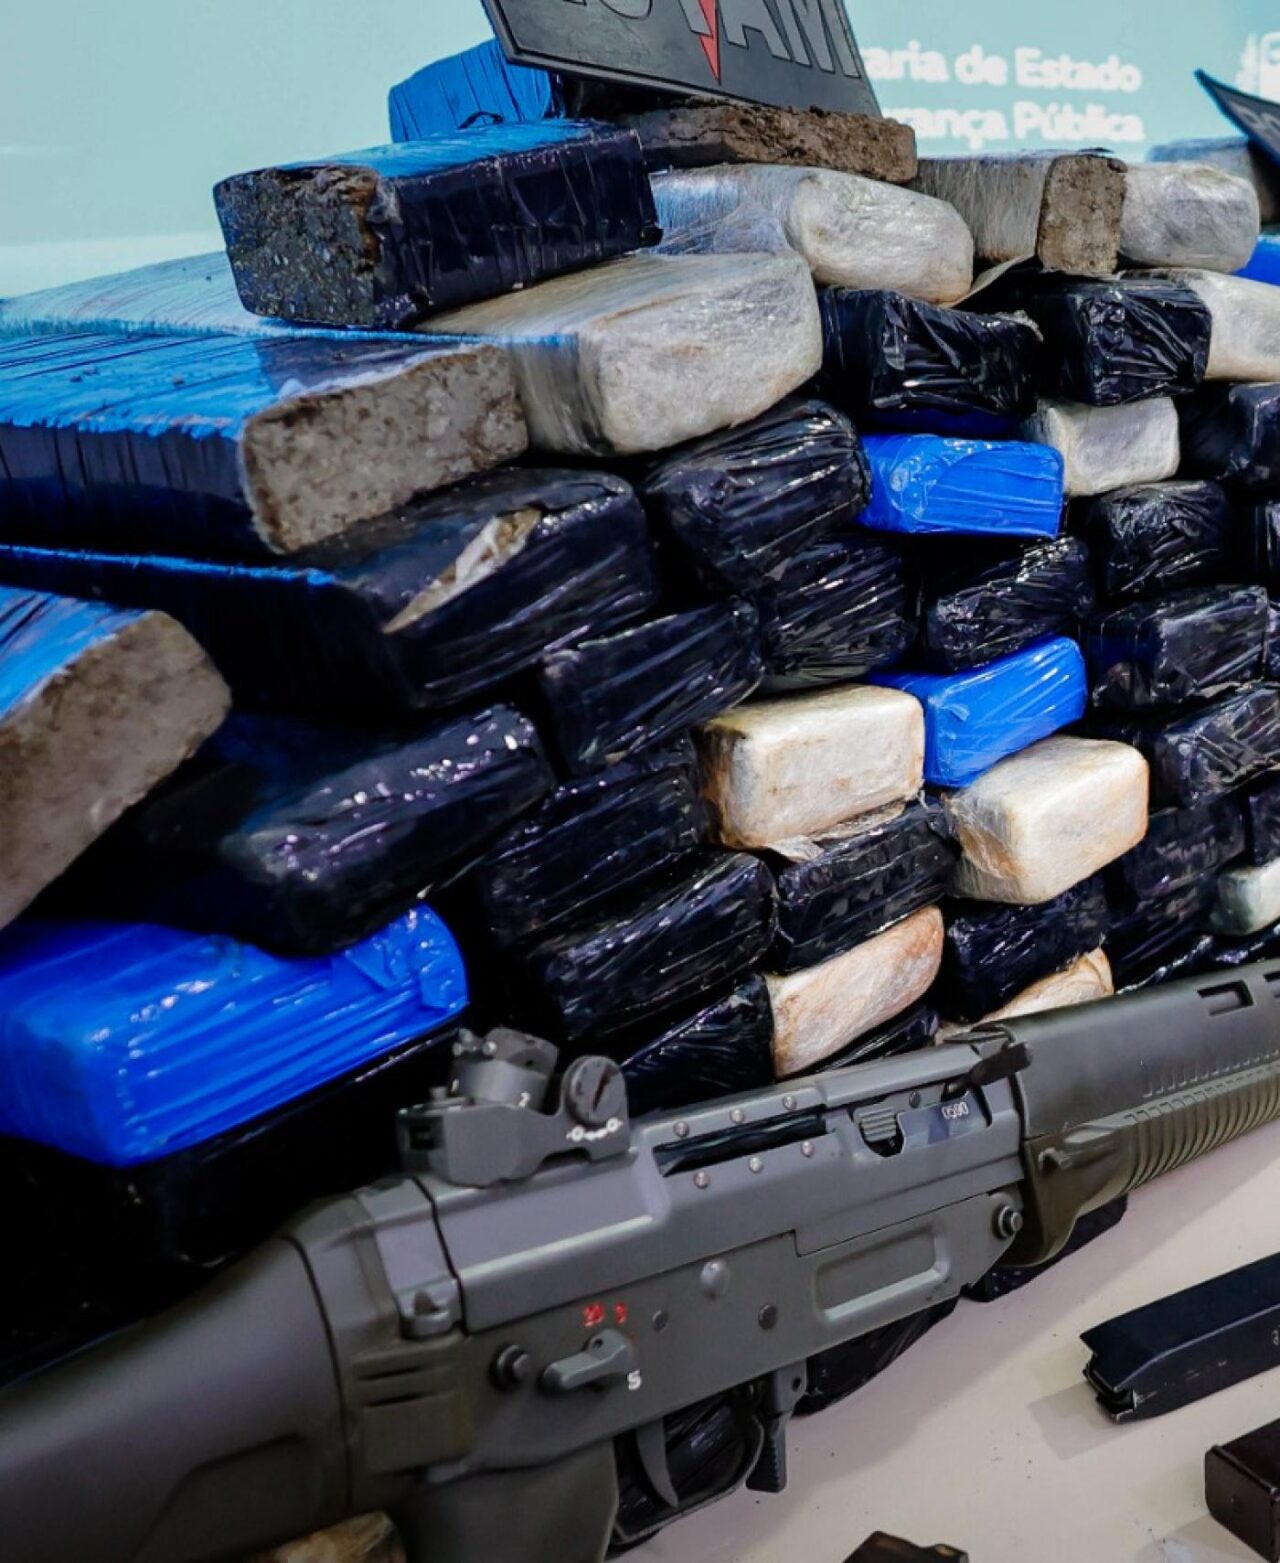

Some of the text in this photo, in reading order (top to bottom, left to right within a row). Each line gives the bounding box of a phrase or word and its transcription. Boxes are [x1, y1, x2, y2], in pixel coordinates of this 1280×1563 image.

[954, 44, 1008, 86] de
[1014, 47, 1142, 93] Estado
[1013, 100, 1145, 141] Pública
